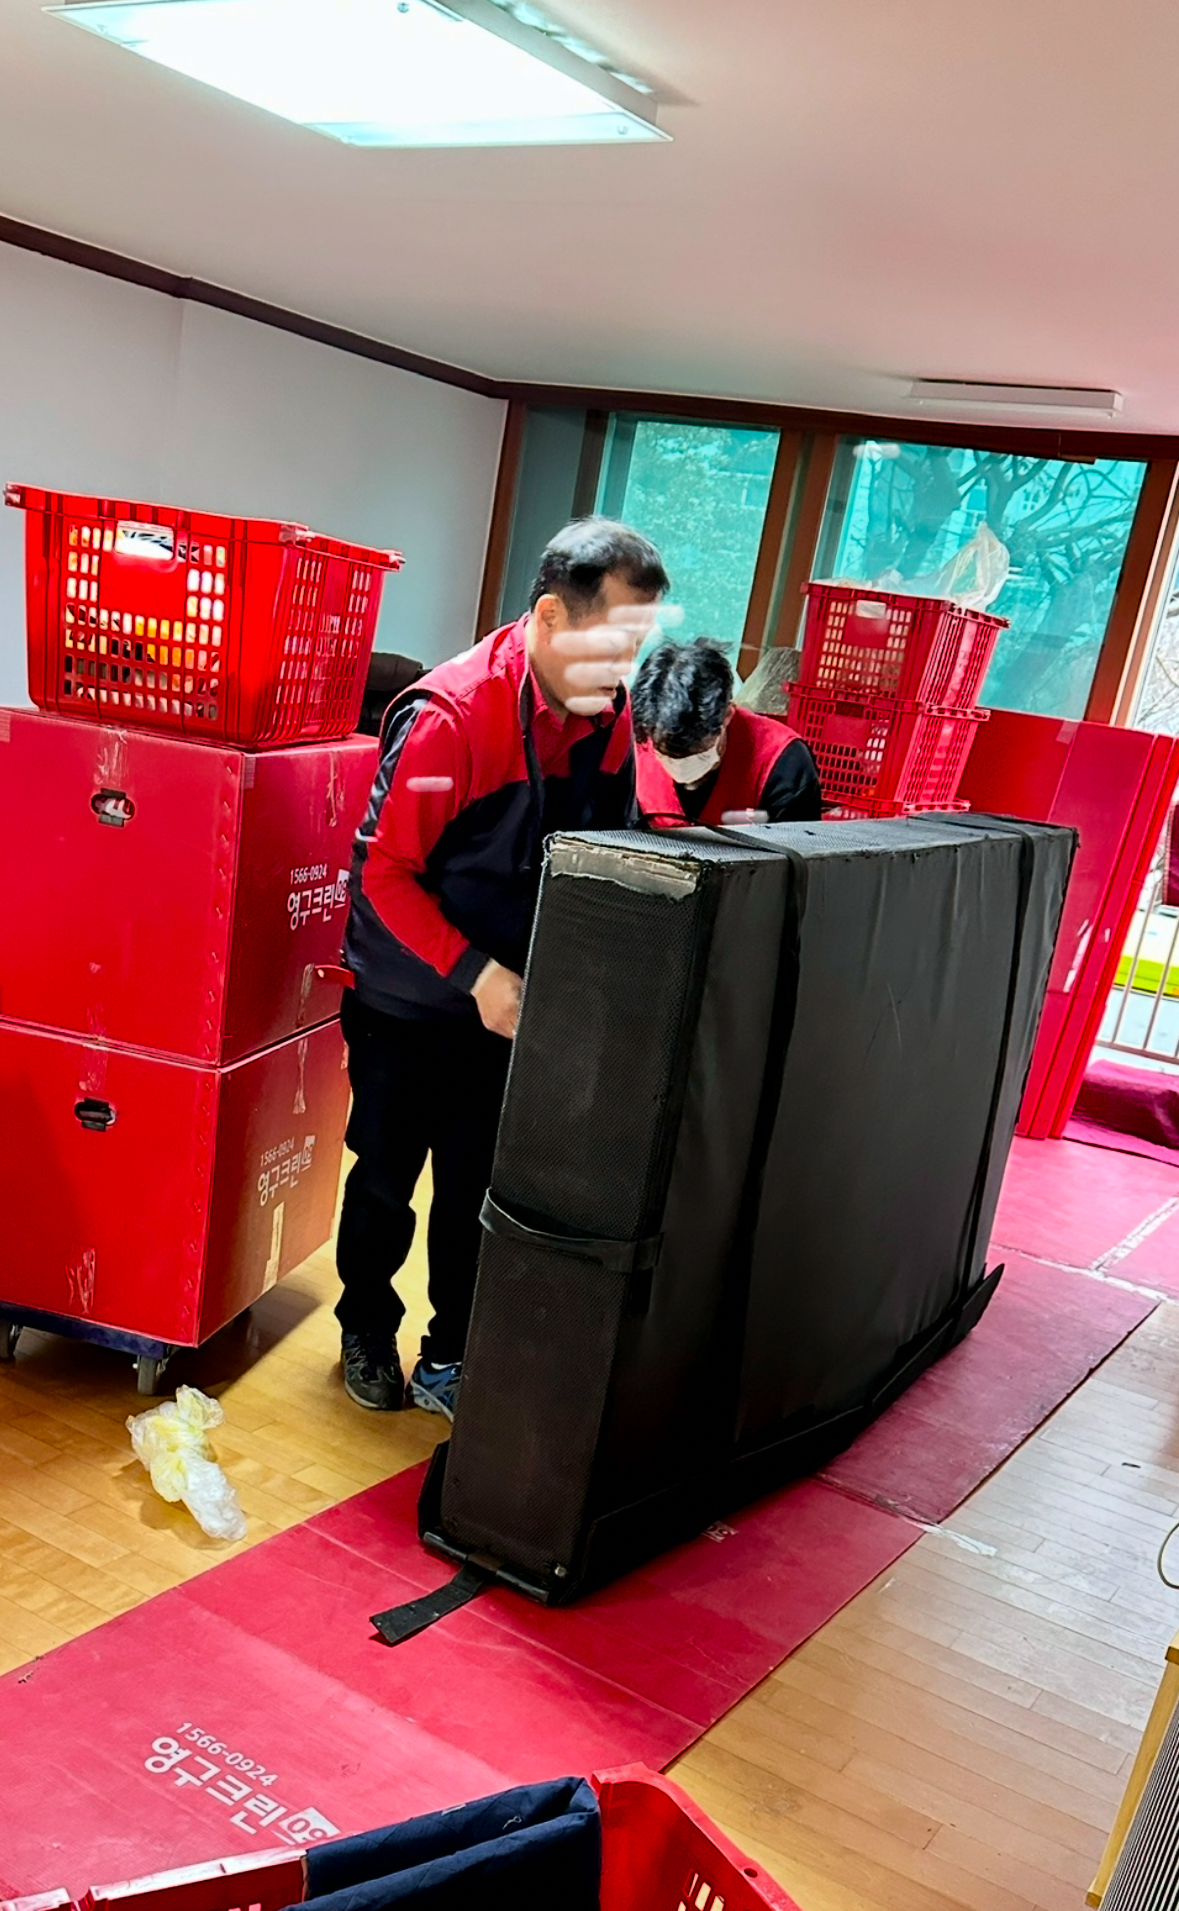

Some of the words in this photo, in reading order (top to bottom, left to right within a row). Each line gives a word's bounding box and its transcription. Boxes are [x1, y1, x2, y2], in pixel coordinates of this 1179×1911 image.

[290, 863, 328, 885] 1566-0924
[287, 883, 336, 931] 영구크린
[257, 1152, 302, 1206] 영구크린
[176, 1722, 278, 1787] 1566-0924
[144, 1736, 287, 1835] 영구크린
